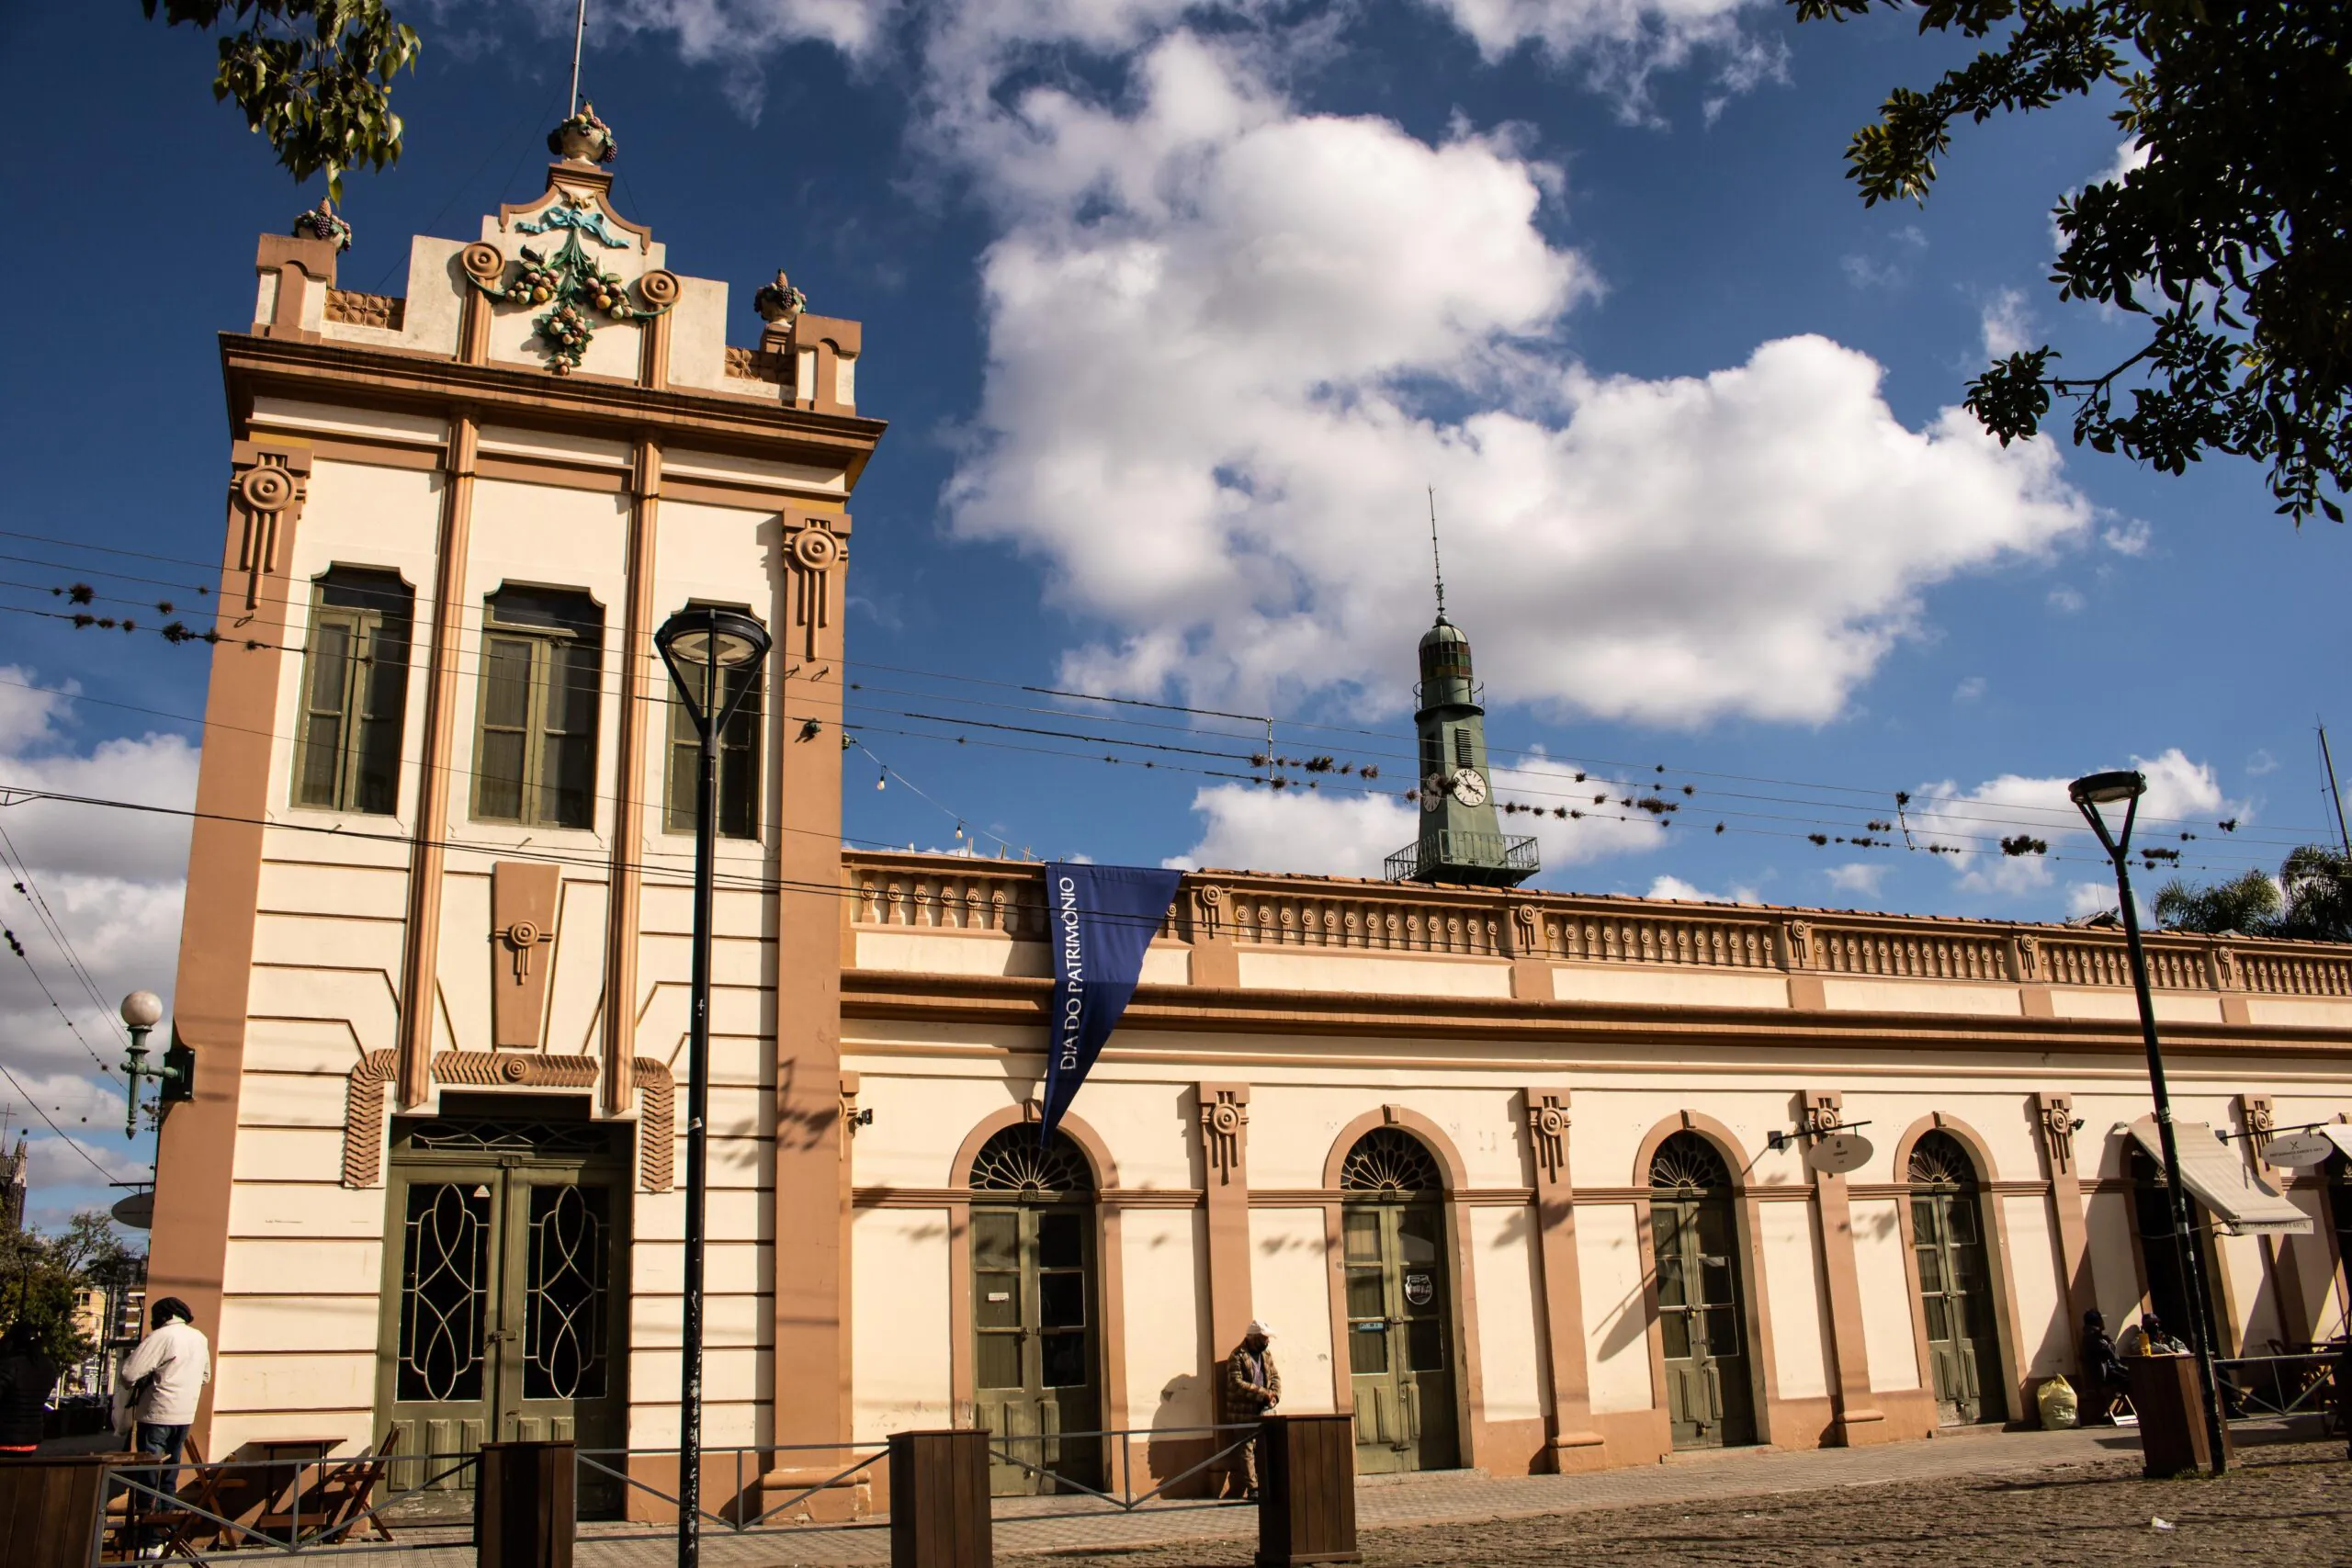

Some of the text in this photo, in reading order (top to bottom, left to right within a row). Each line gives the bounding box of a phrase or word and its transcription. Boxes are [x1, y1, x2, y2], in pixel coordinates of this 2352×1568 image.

[1059, 877, 1083, 1070] DIA DO PATRIMÔNIO
